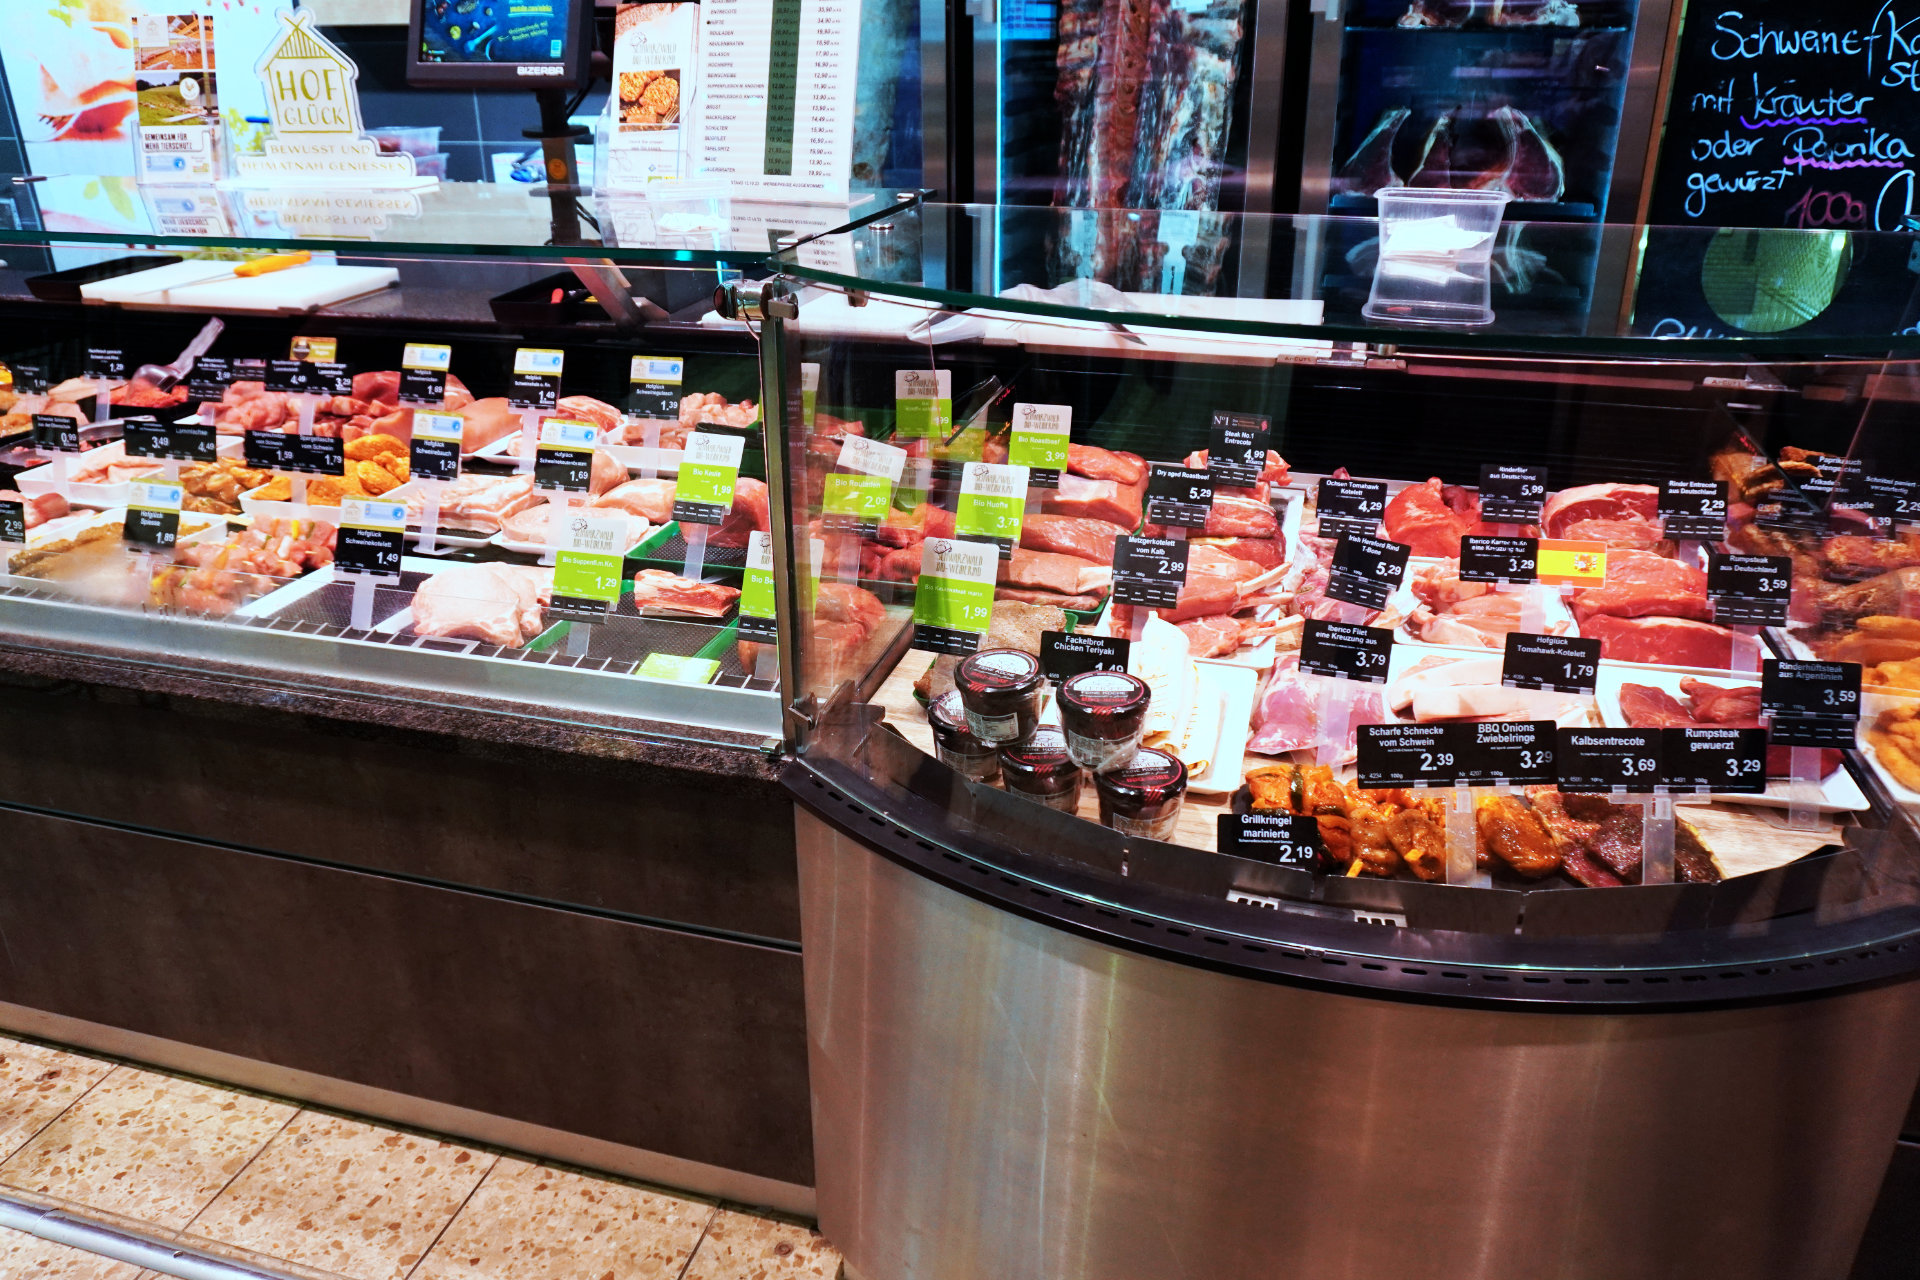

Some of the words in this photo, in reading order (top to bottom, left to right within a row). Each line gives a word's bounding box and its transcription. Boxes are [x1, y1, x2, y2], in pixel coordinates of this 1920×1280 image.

[517, 66, 565, 76] BIZERBA
[276, 69, 338, 101] HOF
[1692, 78, 1735, 114] mit
[284, 103, 345, 125] GLÜCK
[144, 133, 176, 141] GEMEINSAM
[177, 132, 188, 140] FÜR
[144, 142, 160, 150] MEHR
[161, 142, 193, 150] TIERSCHUTZ
[270, 145, 337, 154] BEWUSST
[341, 145, 371, 154] UND
[1691, 130, 1764, 161] oder
[1783, 127, 1916, 176] Paprika
[242, 161, 325, 171] HEIMATNAH
[328, 161, 407, 171] GENIESSEN
[1685, 167, 1794, 217] gewürzt
[645, 383, 665, 391] Hofglück
[660, 400, 678, 411] 1.39
[1018, 435, 1029, 443] Bio
[1224, 429, 1241, 437] Steak
[151, 436, 169, 449] 3.49
[423, 440, 445, 448] Hofglück
[276, 449, 294, 461] 1.59
[324, 454, 343, 466] 1.79
[1045, 450, 1065, 463] 3.99
[1243, 448, 1265, 461] 4.99
[439, 460, 457, 471] 1.29
[569, 470, 589, 482] 1.69
[692, 468, 703, 476] Bio
[1156, 469, 1167, 478] Dry
[1181, 471, 1210, 481] Roastbeef
[835, 478, 847, 487] Bio
[1326, 480, 1348, 488] Ochsen
[1348, 481, 1380, 491] Tomahawk
[1668, 480, 1689, 488] Rinder
[1689, 481, 1718, 489] Entrecote
[712, 484, 732, 497] 1.99
[1189, 487, 1212, 500] 5.29
[1340, 488, 1363, 496] Kotelett
[1521, 484, 1544, 496] 5.99
[1680, 488, 1717, 496] Deutschland
[864, 495, 887, 508] 2.09
[973, 499, 985, 507] Bio
[1358, 500, 1383, 513] 4.29
[1700, 499, 1726, 512] 2.29
[1832, 501, 1876, 510] Frikadelle
[140, 510, 164, 519] Hofglück
[4, 519, 23, 532] 2.99
[996, 515, 1020, 529] 3.79
[1865, 516, 1892, 530] 1.39
[155, 532, 175, 545] 1.89
[356, 529, 382, 539] Hofglück
[345, 538, 392, 548] Schweinekotelett
[1128, 535, 1176, 547] Metzgerkotelett
[1348, 534, 1362, 543] Irish
[1385, 543, 1400, 552] Rind
[1469, 537, 1491, 546] Iberico
[1150, 547, 1166, 555] Kalb
[1361, 545, 1382, 556] T-Bone
[376, 551, 399, 566] 1.49
[562, 556, 573, 564] Bio
[1729, 555, 1769, 564] Rumpsteak
[1158, 560, 1185, 575] 2.99
[1375, 561, 1402, 577] 5.29
[1508, 558, 1535, 573] 3.29
[1733, 565, 1778, 574] Deutschland
[595, 575, 617, 590] 1.29
[751, 574, 763, 584] Bio
[1758, 577, 1788, 592] 3.59
[962, 604, 988, 620] 1.99
[1315, 631, 1331, 639] eine
[1331, 632, 1365, 645] Kreuzung
[1352, 627, 1368, 637] Filet
[1065, 635, 1105, 647] Fackelbrot
[1536, 636, 1569, 646] Hofglück
[1053, 642, 1084, 652] Chicken
[1085, 645, 1115, 656] Teriyaki
[1516, 644, 1586, 658] Tomahawk-Kotelett
[1355, 651, 1386, 668] 3.79
[1562, 662, 1595, 680] 1.79
[1778, 661, 1844, 673] Rinderhüftsteak
[1795, 671, 1844, 681] Argentinien
[1823, 688, 1857, 706] 3.59
[1369, 727, 1402, 737] Scharfe
[1402, 726, 1444, 736] Schnecke
[1477, 723, 1500, 734] BBQ
[1501, 722, 1536, 733] Onions
[1685, 728, 1741, 739] Rumpsteak
[1379, 739, 1398, 747] vom
[1399, 737, 1435, 747] Schwein
[1476, 733, 1536, 744] Zwiebelringe
[1570, 735, 1646, 747] Kalbsentrecote
[1690, 740, 1736, 752] gewuerzt
[1420, 752, 1455, 771] 2.39
[1519, 750, 1553, 769] 3.29
[1621, 757, 1657, 777] 3.69
[1726, 758, 1762, 777] 3.29
[1241, 814, 1292, 828] Grillkringel
[1243, 828, 1290, 839] marinierte
[1279, 844, 1314, 863] 2.19
